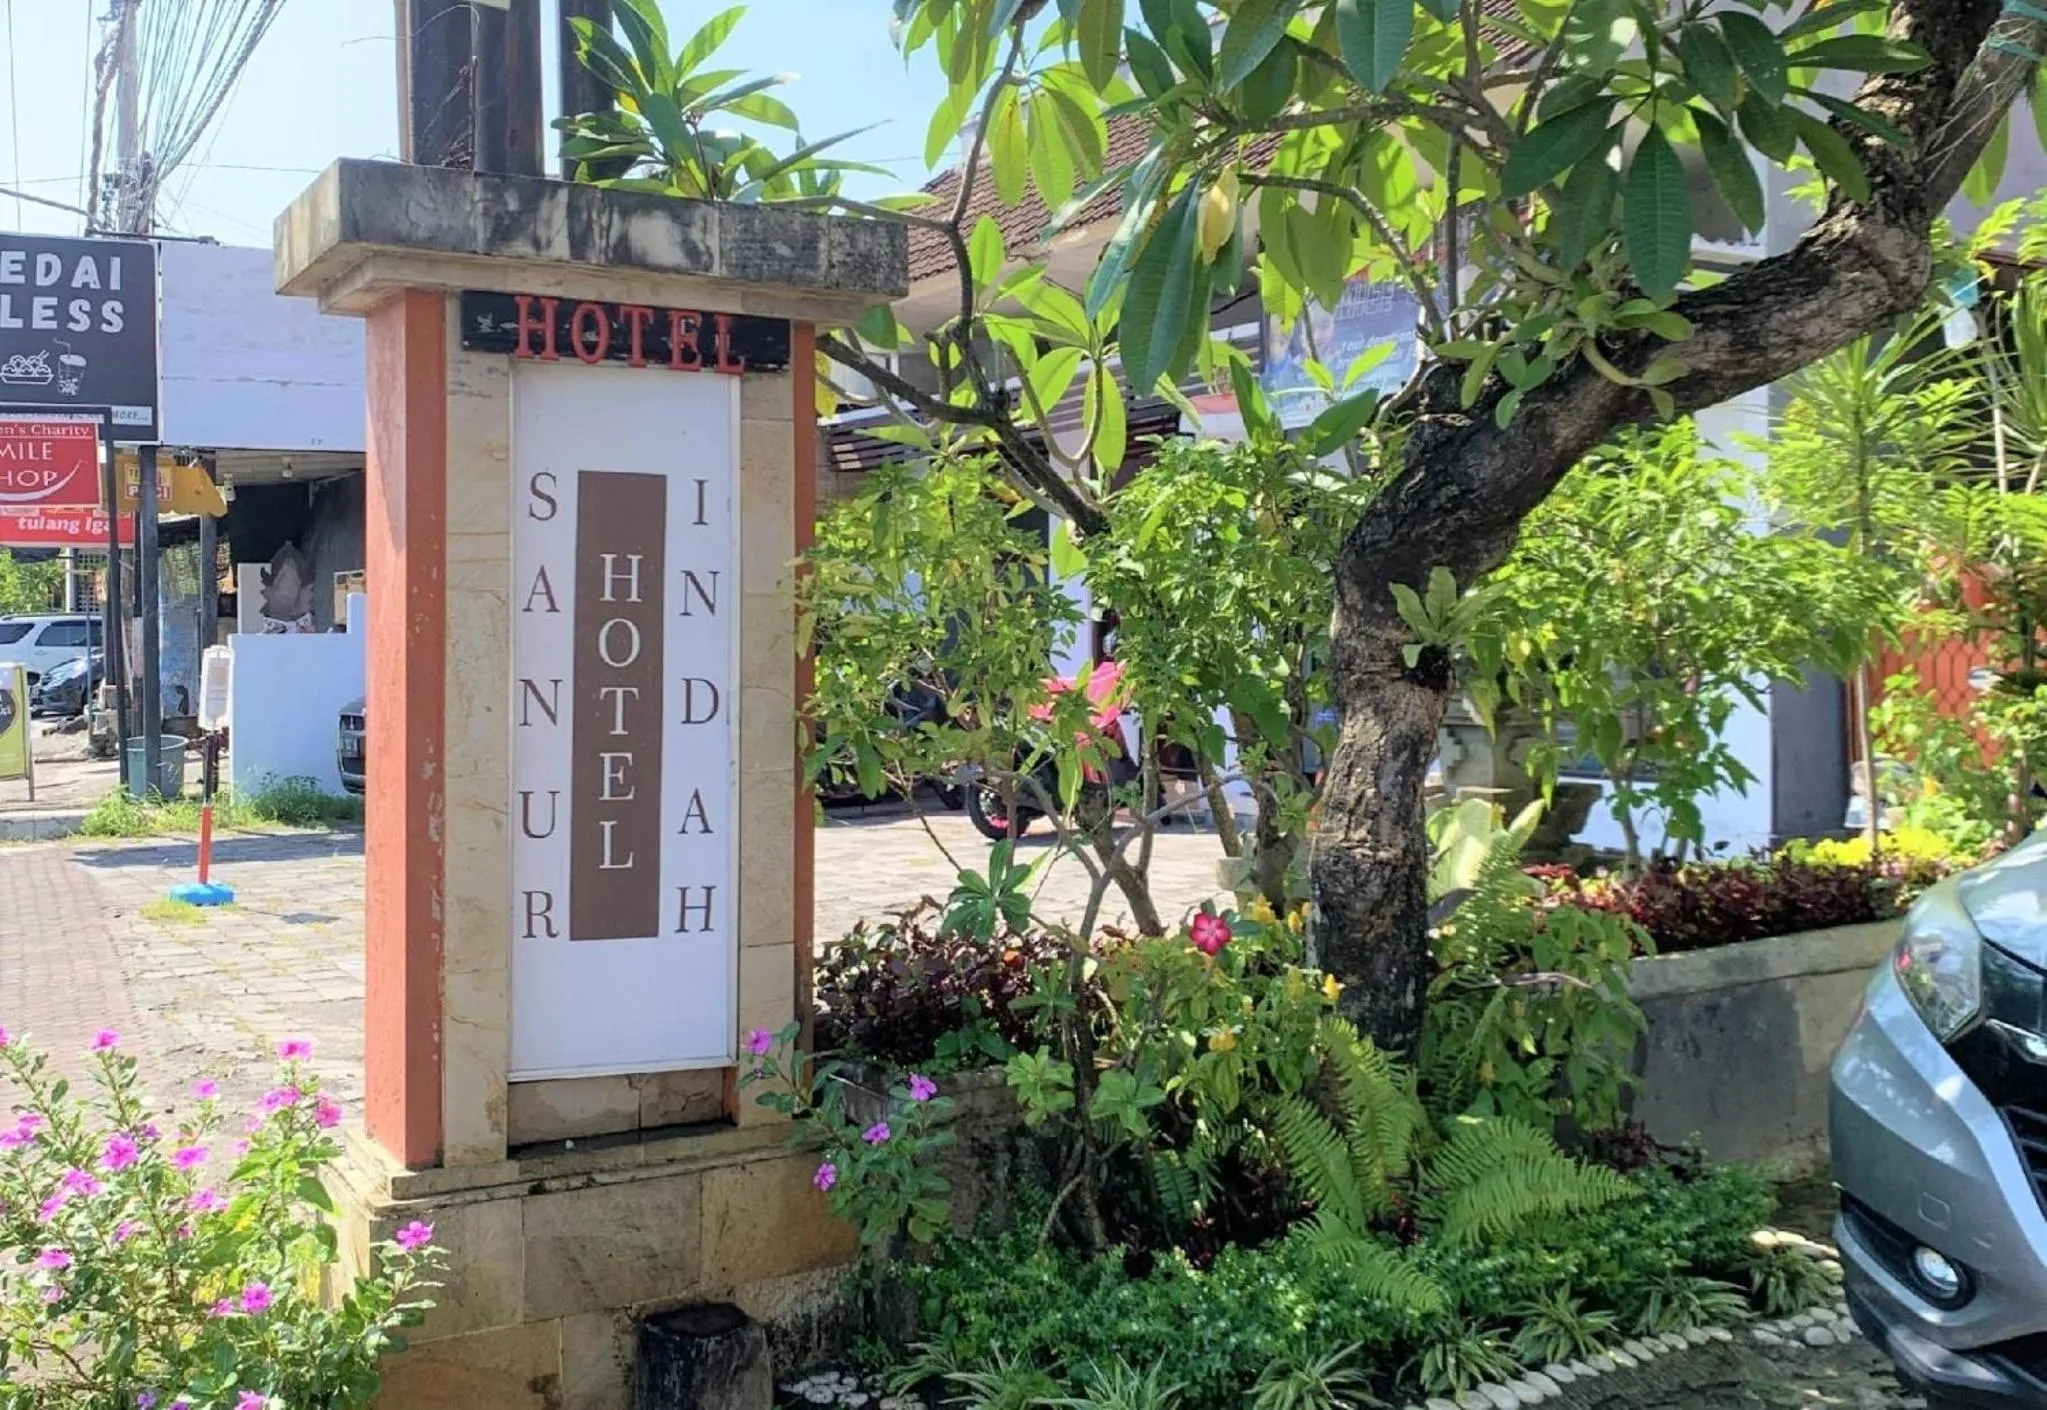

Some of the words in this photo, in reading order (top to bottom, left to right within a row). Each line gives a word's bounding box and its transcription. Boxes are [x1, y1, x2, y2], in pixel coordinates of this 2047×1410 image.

[0, 250, 121, 290] EDAI
[0, 294, 124, 333] LESS
[513, 295, 746, 377] HOTEL
[31, 423, 90, 437] Charity
[18, 514, 80, 535] tulang
[518, 471, 564, 939] SANUR
[598, 553, 644, 869] HOTEL
[674, 479, 721, 934] INDAH
